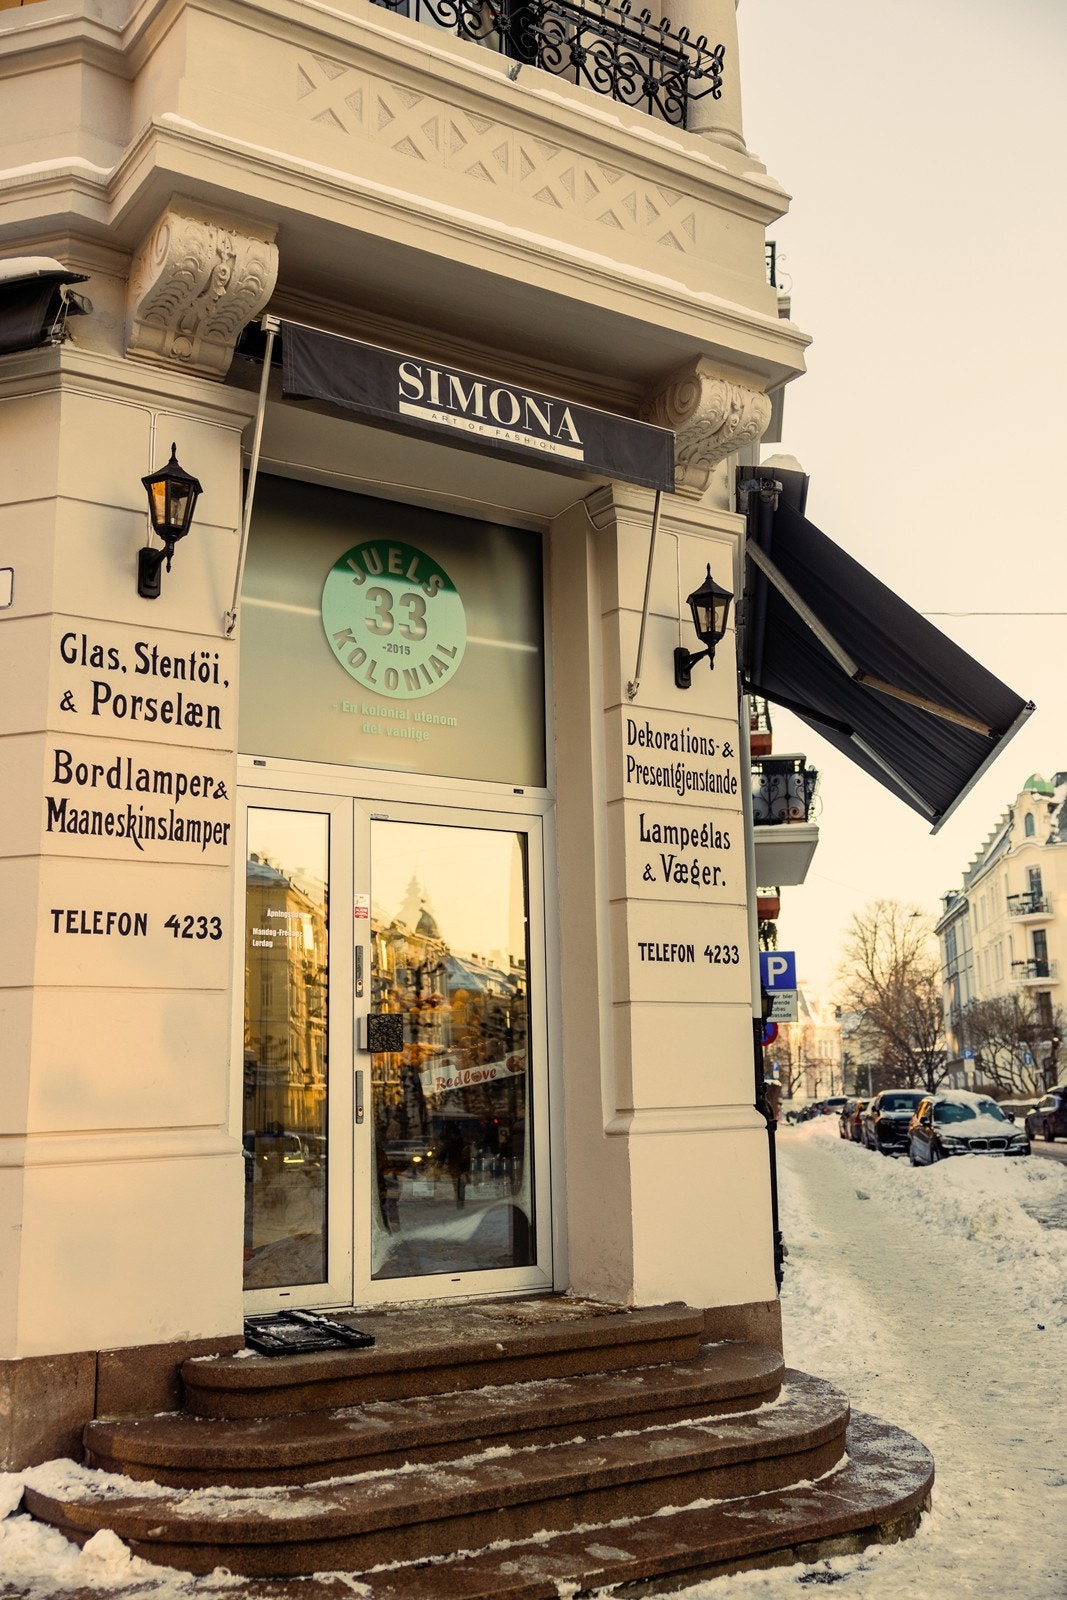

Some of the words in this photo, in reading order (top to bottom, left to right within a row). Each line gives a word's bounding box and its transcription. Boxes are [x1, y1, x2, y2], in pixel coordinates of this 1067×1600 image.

[398, 362, 584, 445] SIMONA
[431, 413, 457, 425] ART
[468, 423, 484, 432] OF
[495, 429, 557, 451] FASHION
[346, 547, 445, 598] JUELS
[365, 586, 428, 642] 33
[60, 633, 127, 674] Glas,
[332, 627, 458, 692] KOLONIAL
[60, 690, 78, 713] &
[91, 680, 222, 730] Porselæn
[342, 699, 358, 713] En
[361, 703, 410, 720] kolonial
[414, 711, 458, 726] utenom
[362, 722, 382, 735] det
[386, 726, 430, 742] vanlige
[627, 755, 738, 797] Presentgjenstande
[44, 796, 231, 852] Maaneskinslamper
[639, 813, 731, 852] Lampeglas
[643, 863, 657, 882] &
[660, 854, 726, 888] Væger.
[51, 909, 148, 936] TELEFON
[163, 914, 223, 940] 4233
[638, 943, 695, 962] TELEFON
[704, 945, 740, 964] 4233
[767, 956, 788, 986] P
